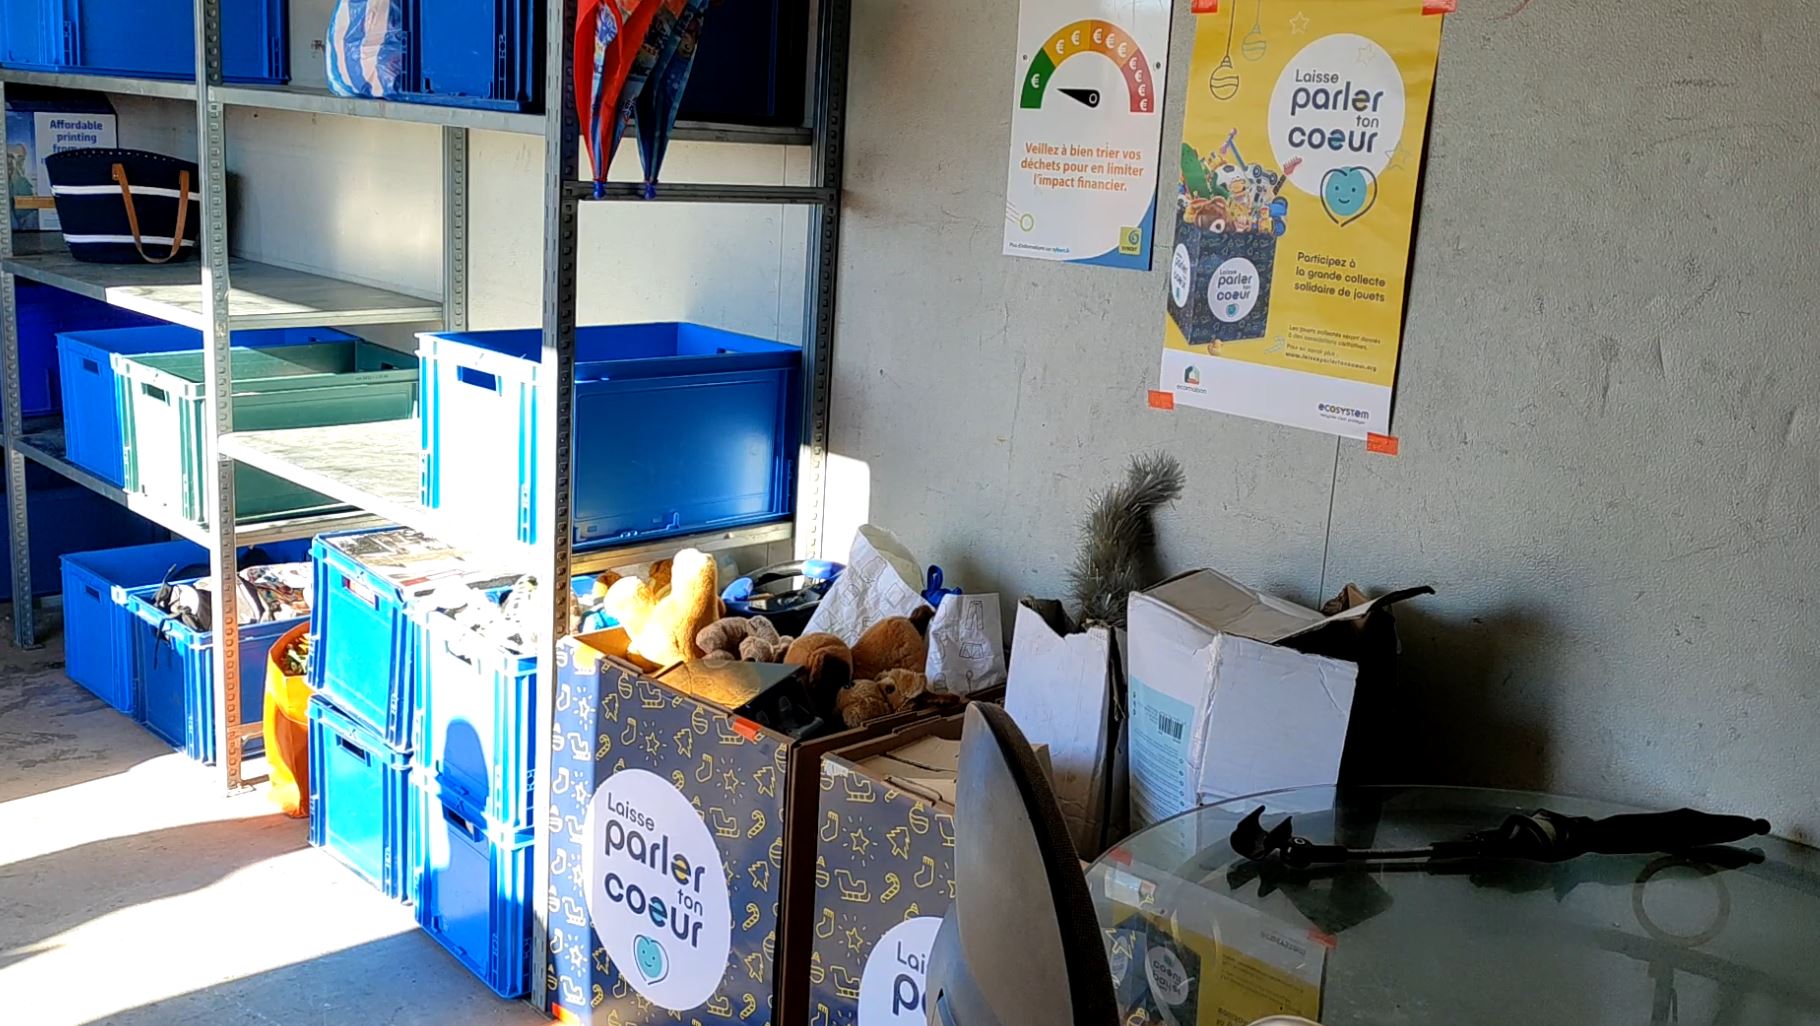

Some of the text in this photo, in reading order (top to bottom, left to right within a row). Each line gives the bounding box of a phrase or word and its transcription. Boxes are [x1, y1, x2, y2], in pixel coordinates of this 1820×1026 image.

[1295, 69, 1339, 83] Laisse
[1290, 81, 1384, 116] parler
[50, 119, 103, 130] Affordable
[1356, 115, 1379, 128] ton
[57, 132, 97, 144] printing
[1288, 126, 1378, 153] coeur
[1025, 142, 1142, 160] Veillez à bien trier vos
[1020, 157, 1144, 176] déchets pour en limiter
[1033, 173, 1127, 192] l'impact financier.
[1297, 251, 1356, 268] Participez à
[1217, 273, 1253, 288] parler
[1295, 266, 1386, 287] la grande collecte
[1216, 291, 1251, 301] coeur
[1294, 282, 1385, 302] solidaire de jouets
[1318, 403, 1369, 420] ecosystem
[607, 792, 655, 831] Laisse
[605, 819, 705, 893] parler
[604, 872, 703, 948] coeur
[678, 889, 703, 916] ton
[897, 941, 925, 975] Lai
